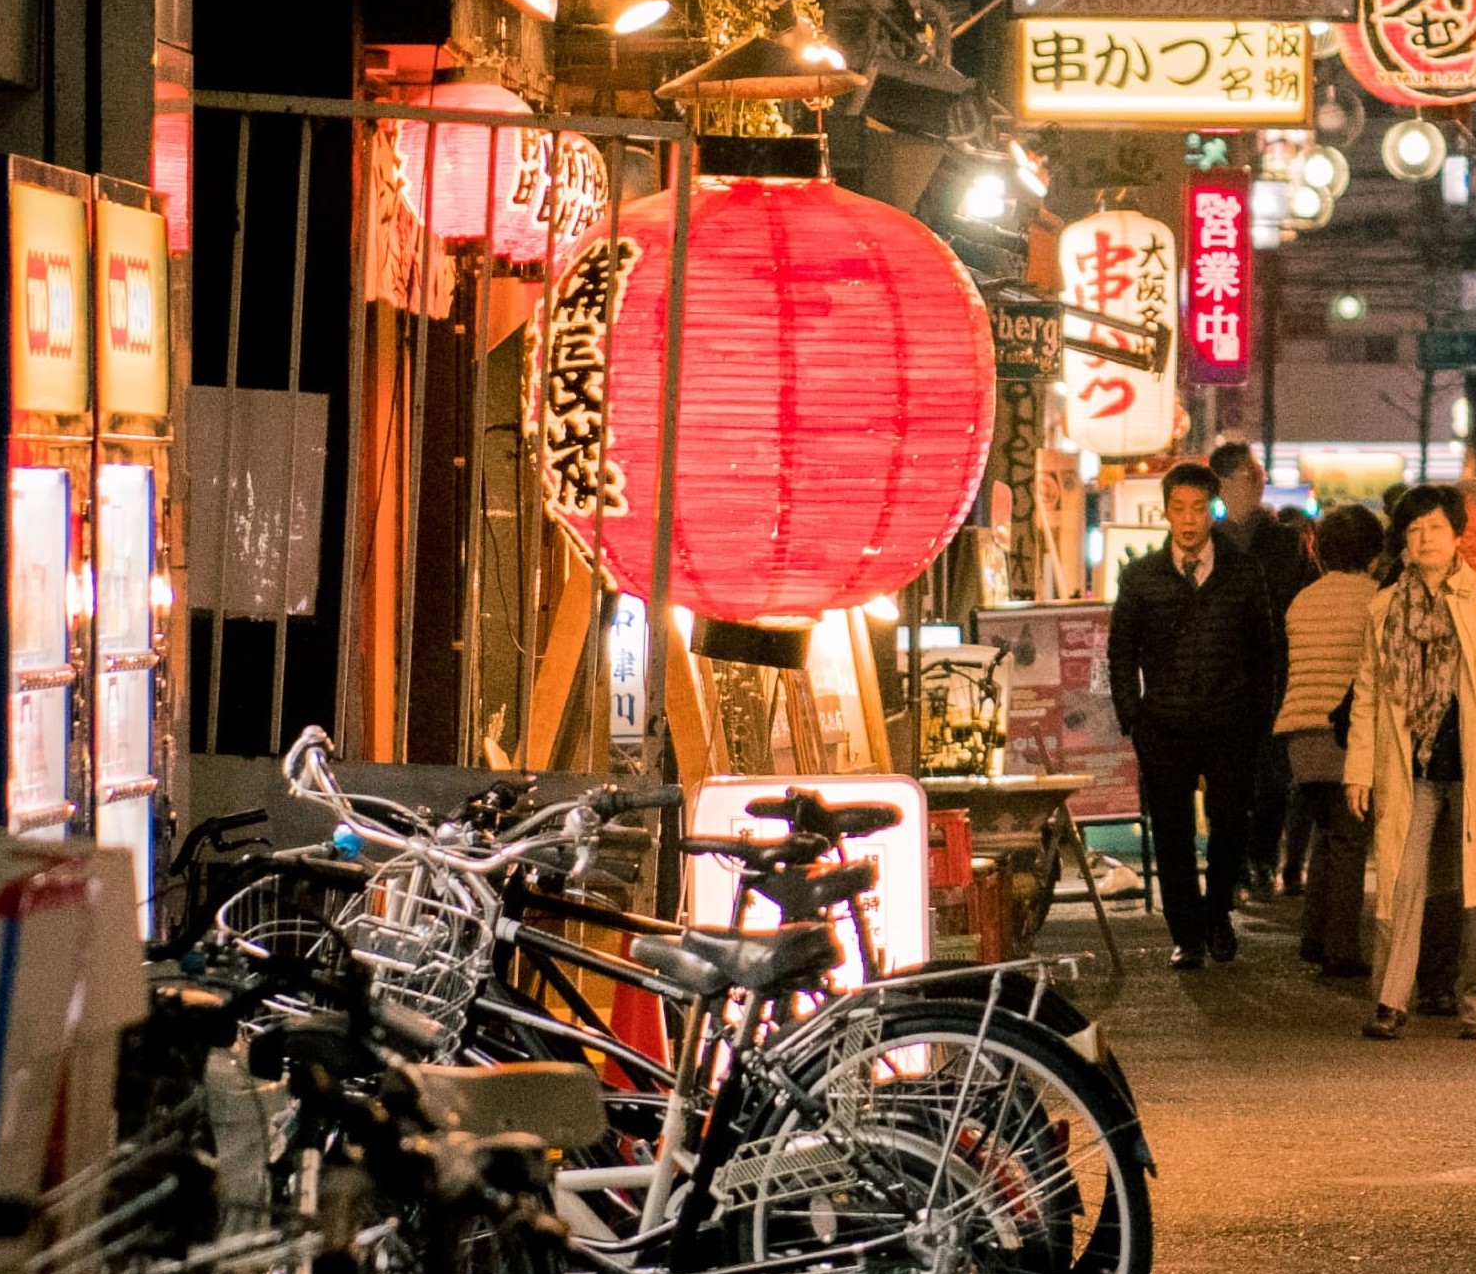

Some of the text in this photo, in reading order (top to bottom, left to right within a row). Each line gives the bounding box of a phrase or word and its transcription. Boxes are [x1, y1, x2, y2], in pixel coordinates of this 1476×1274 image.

[1030, 29, 1213, 91] 串かつ
[1194, 192, 1242, 362] 営業中
